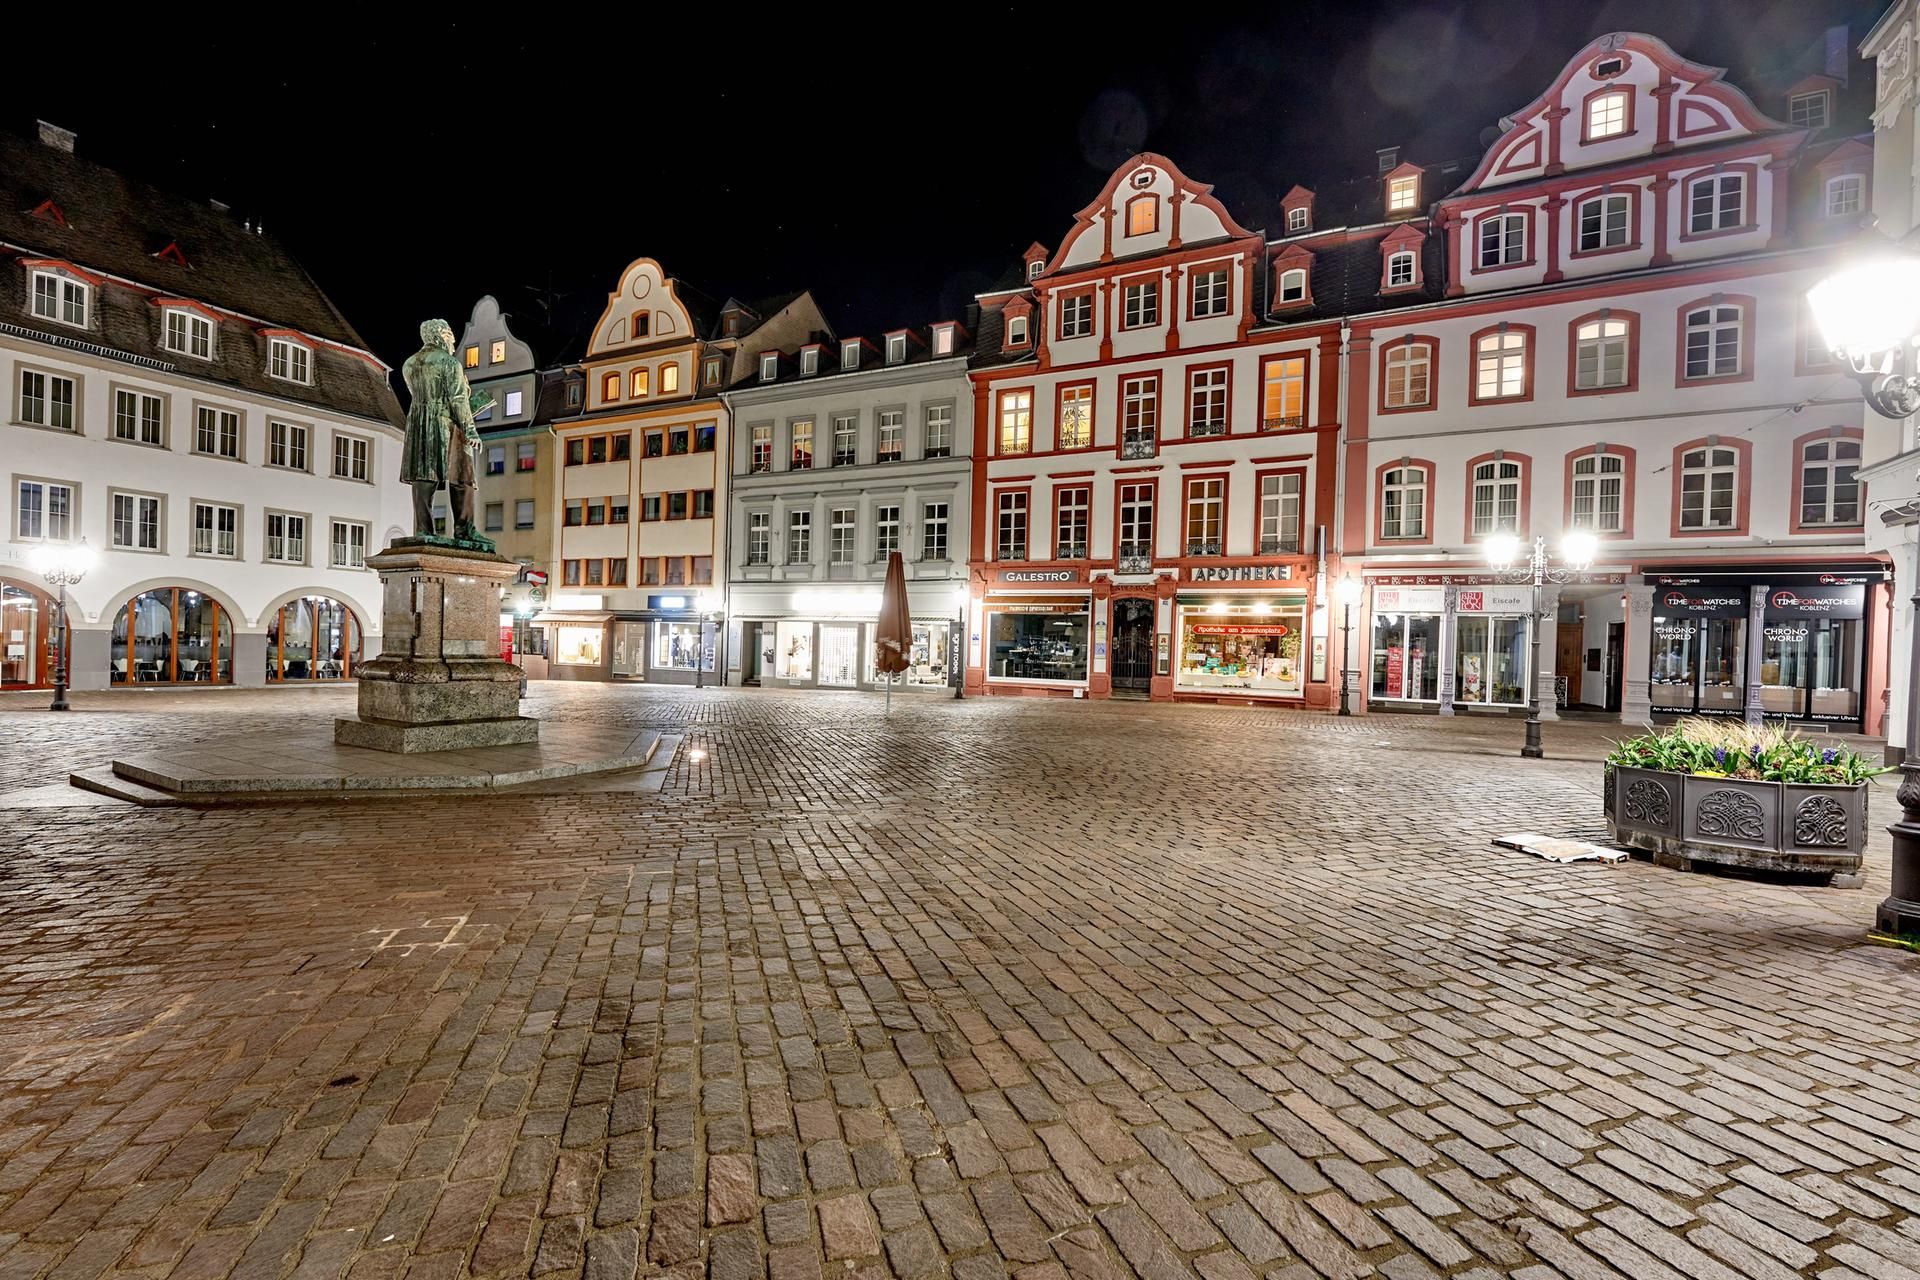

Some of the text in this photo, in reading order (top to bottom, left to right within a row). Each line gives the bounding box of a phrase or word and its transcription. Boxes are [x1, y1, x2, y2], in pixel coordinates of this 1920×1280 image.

[1196, 566, 1287, 581] APOTHEKE
[1198, 626, 1226, 634] Apotheke
[1763, 628, 1809, 636] CHRONO
[1659, 633, 1692, 641] WORLD
